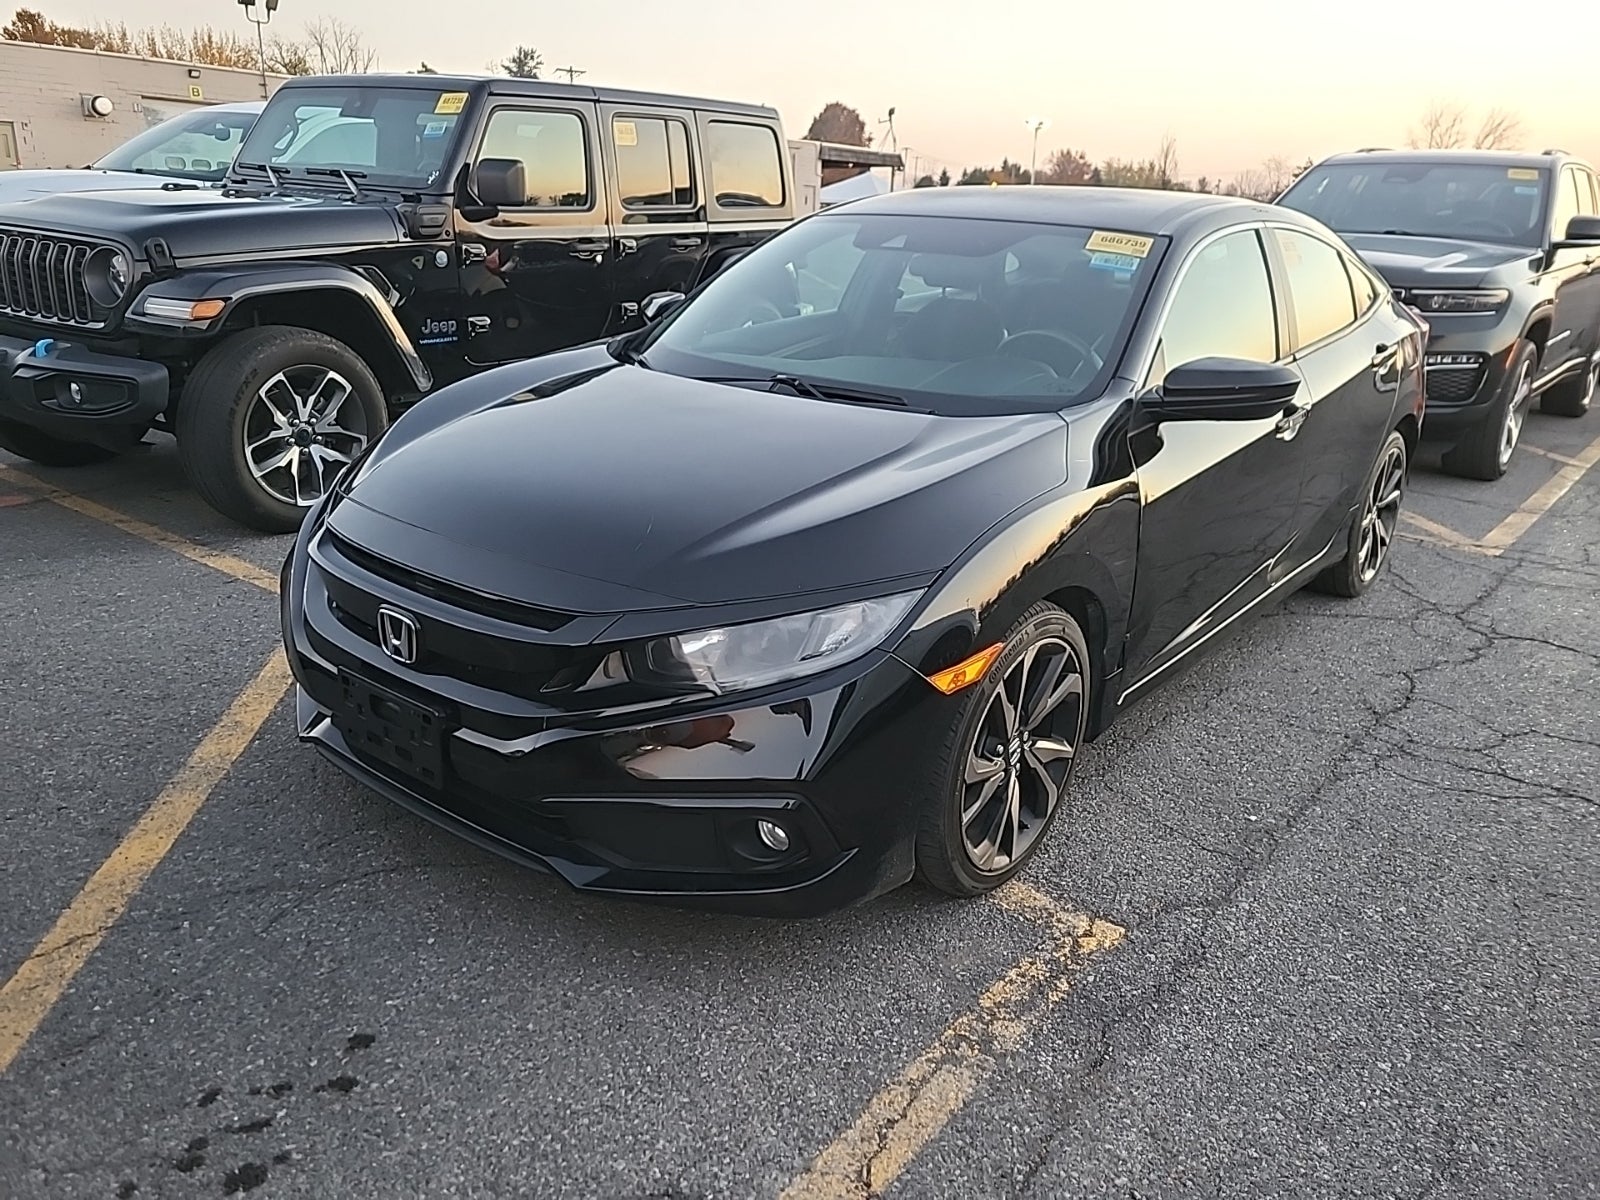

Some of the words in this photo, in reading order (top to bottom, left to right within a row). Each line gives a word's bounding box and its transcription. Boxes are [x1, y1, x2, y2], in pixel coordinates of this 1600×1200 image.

[191, 87, 200, 97] B
[1100, 235, 1147, 249] 686739
[421, 318, 457, 335] Jeep
